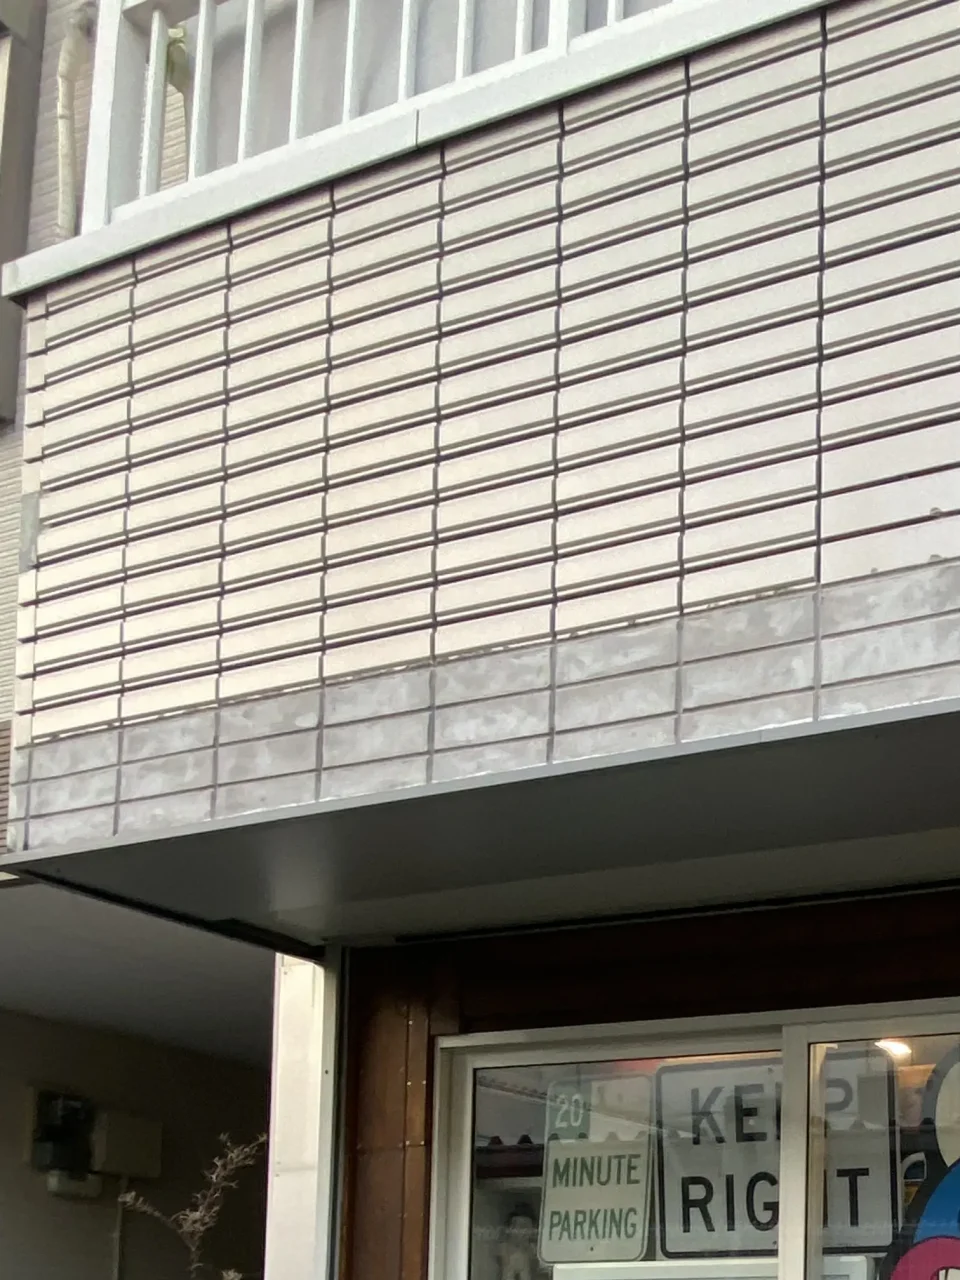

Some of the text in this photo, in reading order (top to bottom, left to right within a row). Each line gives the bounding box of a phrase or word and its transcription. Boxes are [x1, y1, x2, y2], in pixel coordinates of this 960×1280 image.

[554, 1093, 585, 1129] 20
[690, 1078, 854, 1146] KEP
[552, 1153, 641, 1189] MINUTE
[681, 1168, 870, 1234] RIGT
[548, 1207, 638, 1242] PARKING
